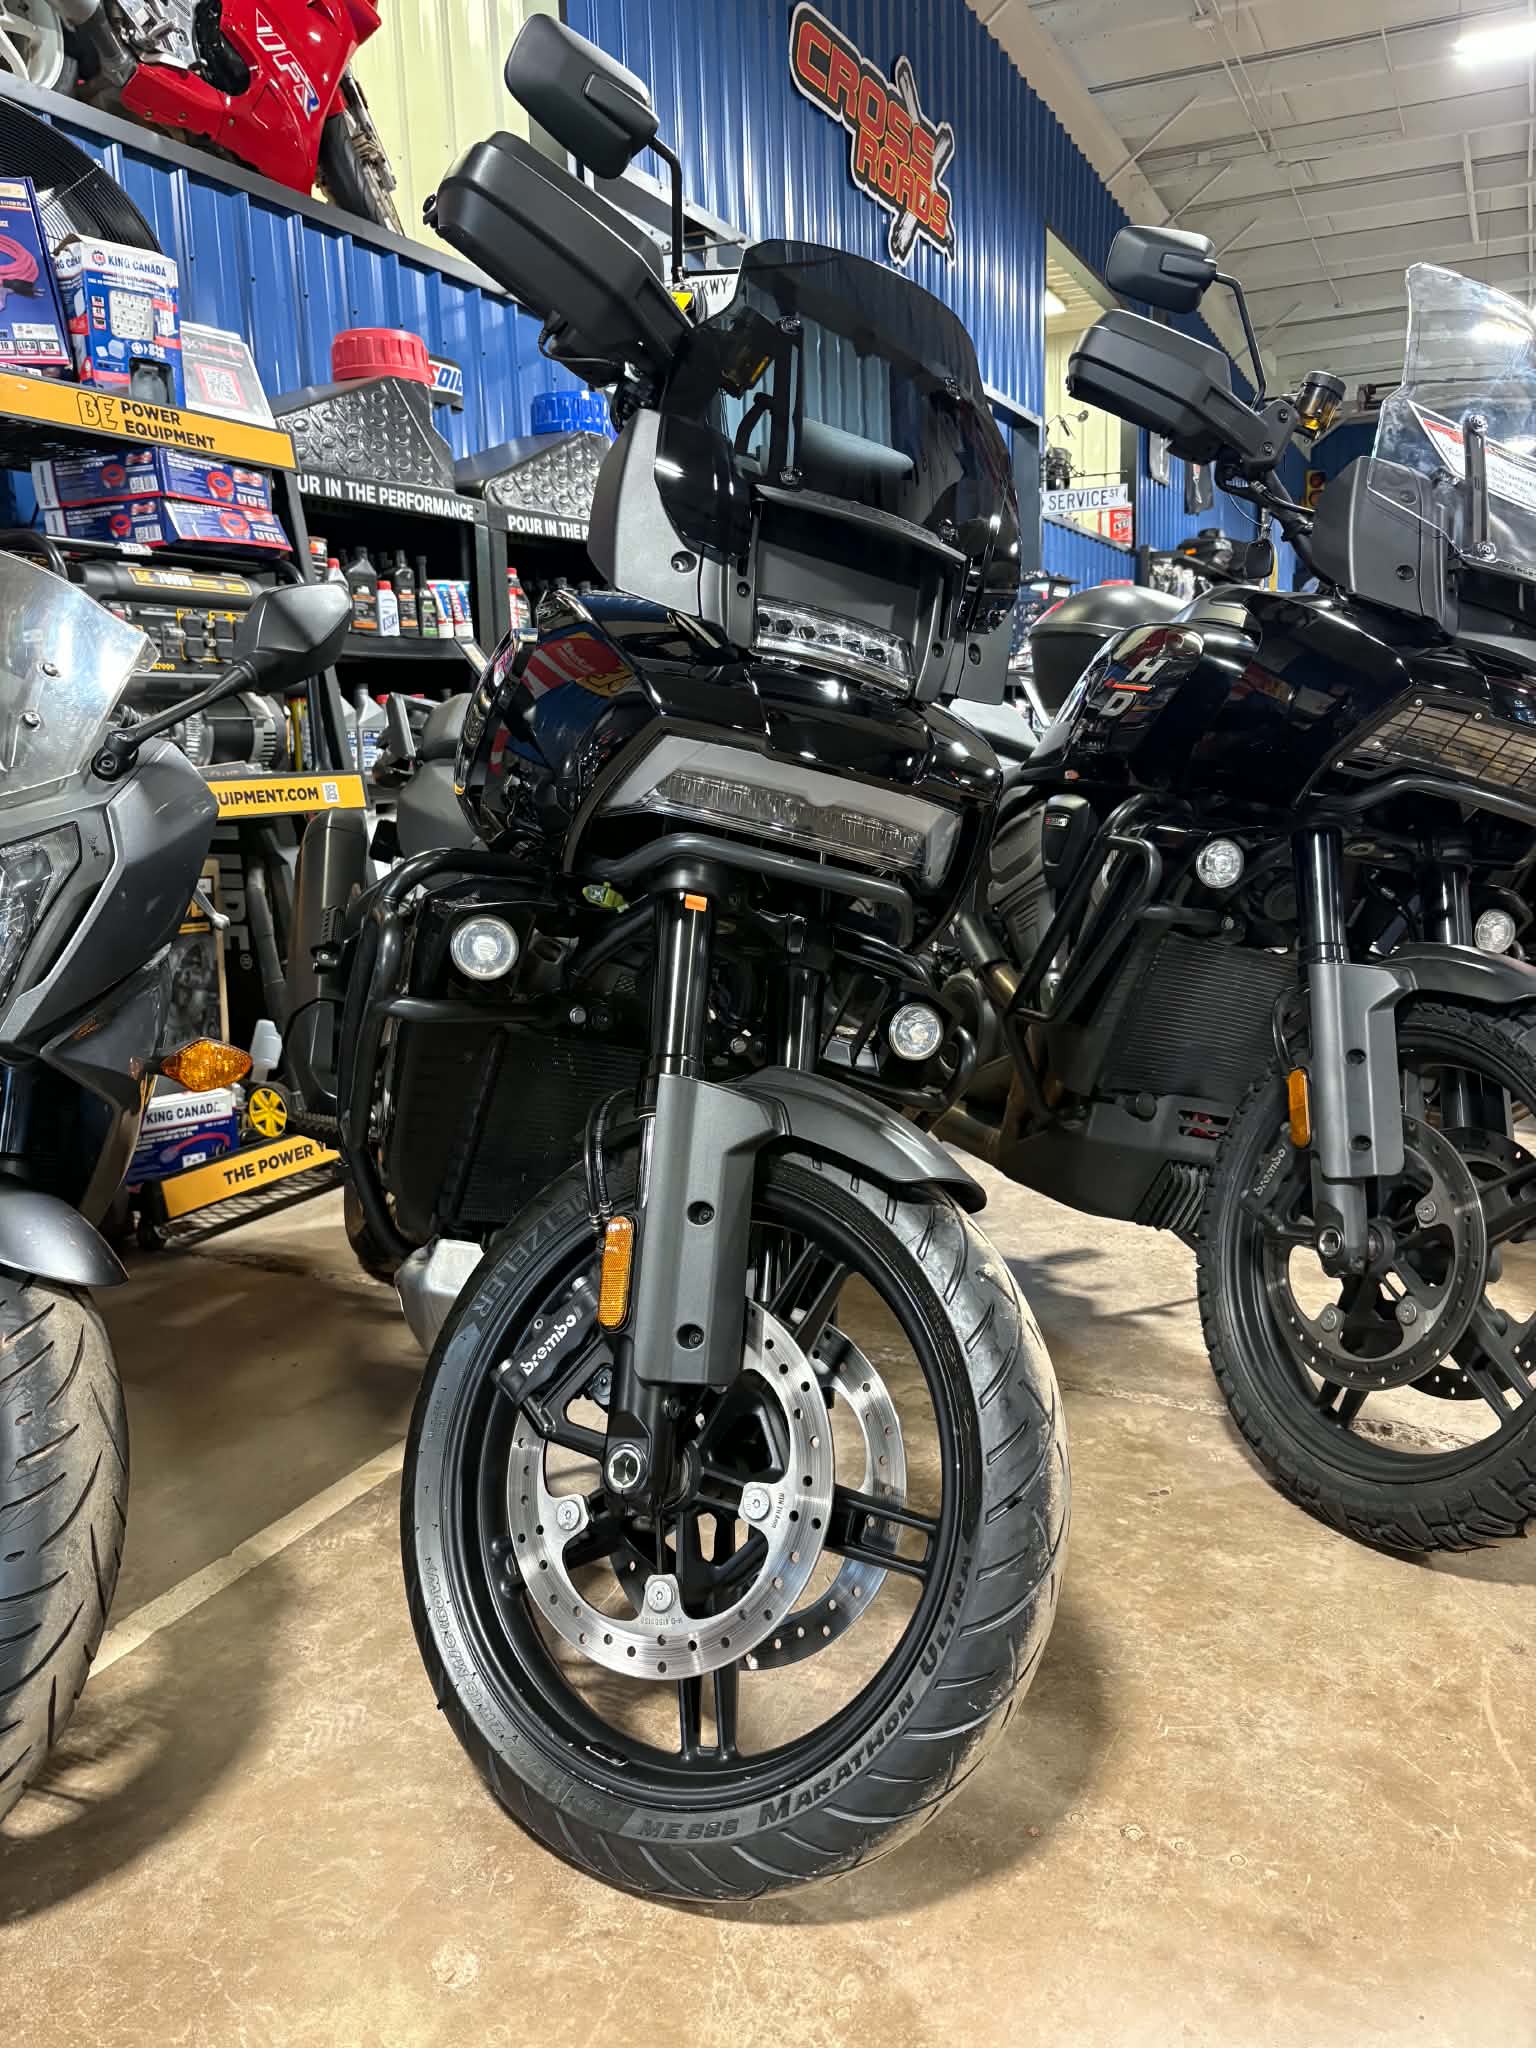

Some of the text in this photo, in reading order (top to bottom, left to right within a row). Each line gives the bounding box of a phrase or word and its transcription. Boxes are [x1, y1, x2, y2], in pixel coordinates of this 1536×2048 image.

[797, 21, 936, 185] CROSS
[857, 127, 947, 239] ROADS
[108, 255, 167, 277] KING CANADA
[120, 401, 180, 426] POWER
[125, 420, 215, 449] EQUIPMENT
[325, 478, 341, 498] IN
[345, 481, 376, 503] THE
[379, 487, 475, 522] PERFORMANCE
[1048, 489, 1110, 511] SERVICE
[507, 515, 543, 535] POUR
[545, 519, 557, 537] IN
[559, 522, 582, 539] THE
[146, 1109, 173, 1125] KING
[223, 1163, 256, 1185] THE
[258, 1144, 314, 1174] POWER
[1253, 1149, 1286, 1197] brembo
[520, 1314, 577, 1377] brembo
[757, 1692, 915, 1828] MARATHON
[919, 1556, 972, 1678] ULTRA
